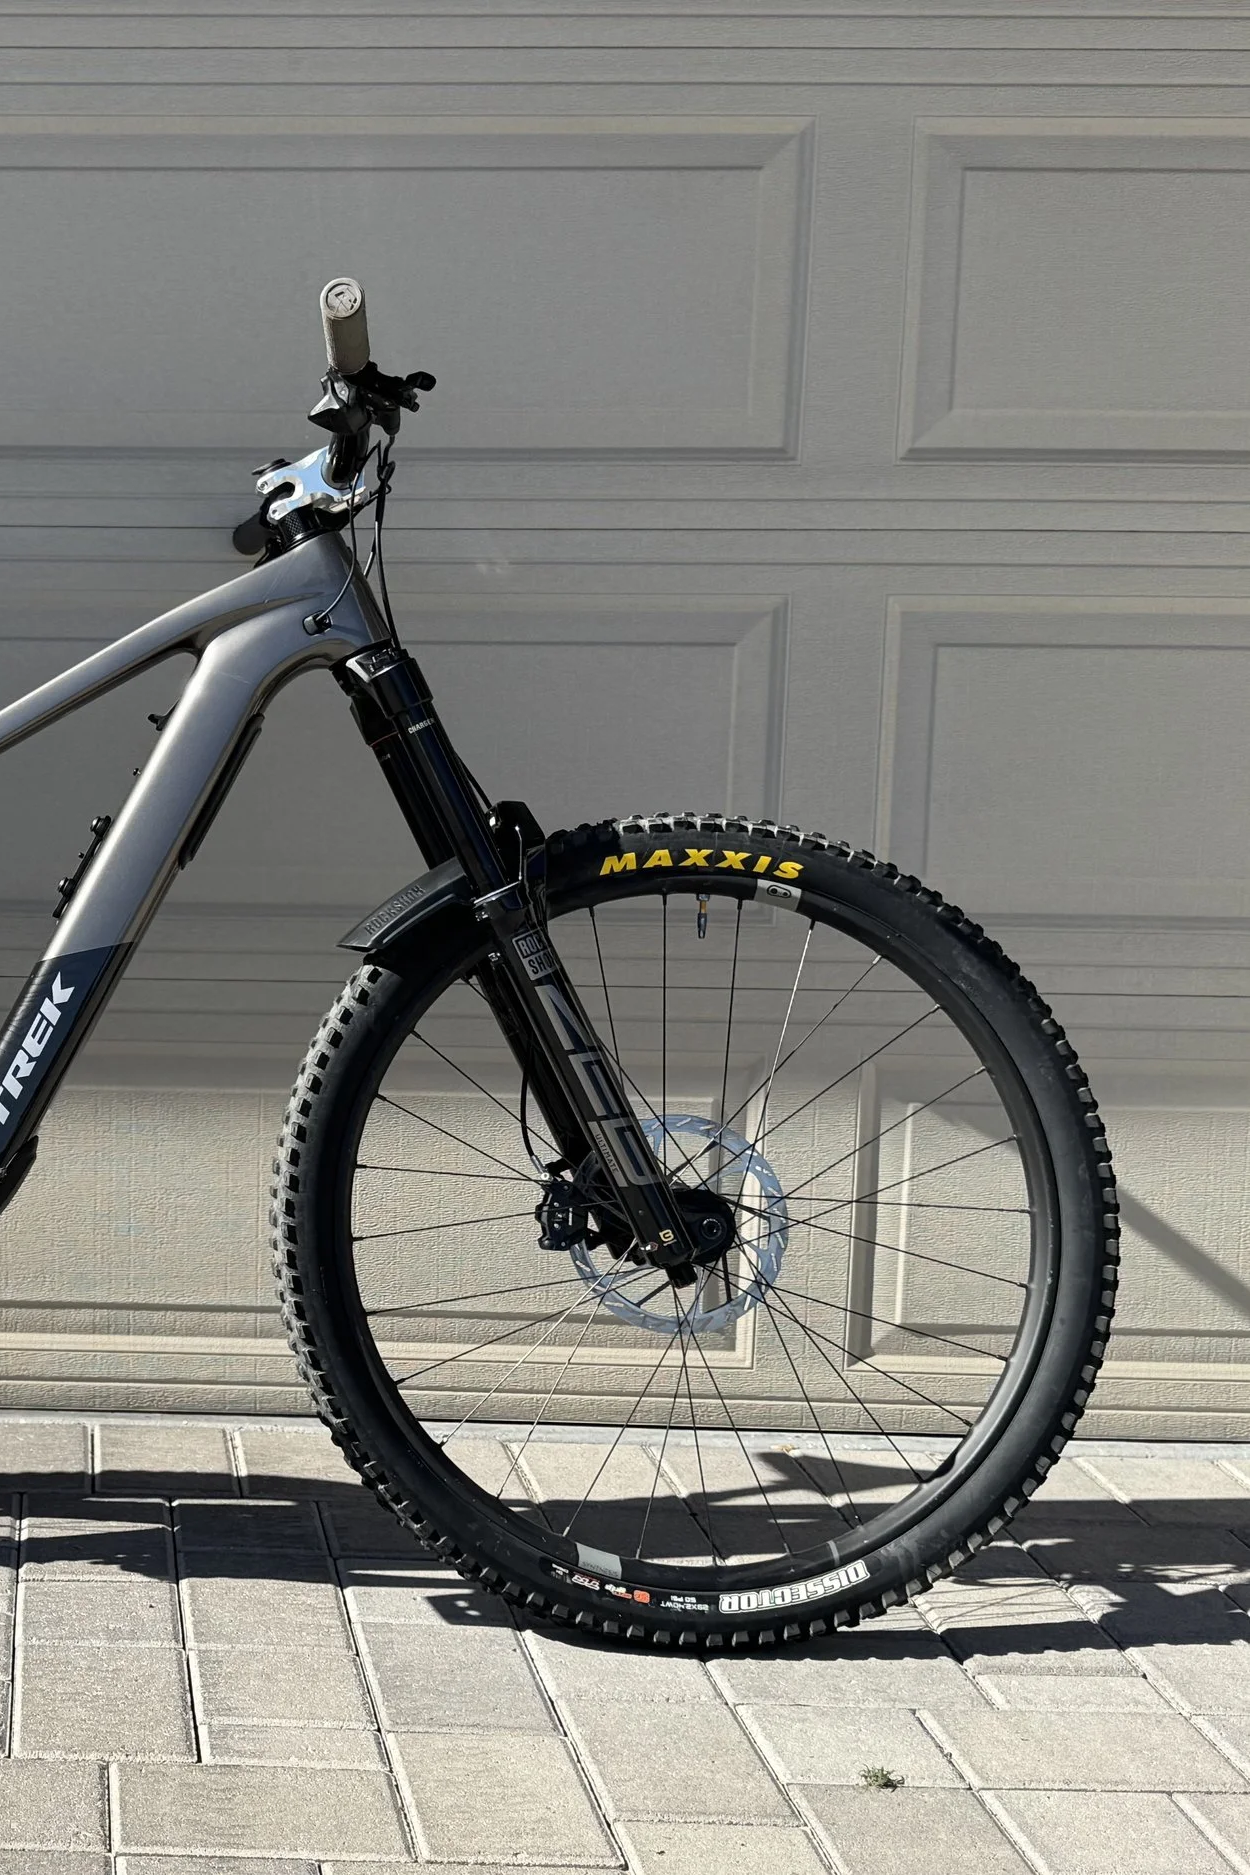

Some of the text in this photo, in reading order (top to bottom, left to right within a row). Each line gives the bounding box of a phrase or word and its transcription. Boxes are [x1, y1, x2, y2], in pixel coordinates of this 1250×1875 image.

[600, 848, 804, 879] MAXXIS
[364, 884, 426, 935] ROCKSHOX
[517, 933, 546, 956] ROC
[528, 951, 556, 975] SHO
[595, 1133, 620, 1174] ULTIMATE
[718, 1559, 871, 1614] DISSECTOR
